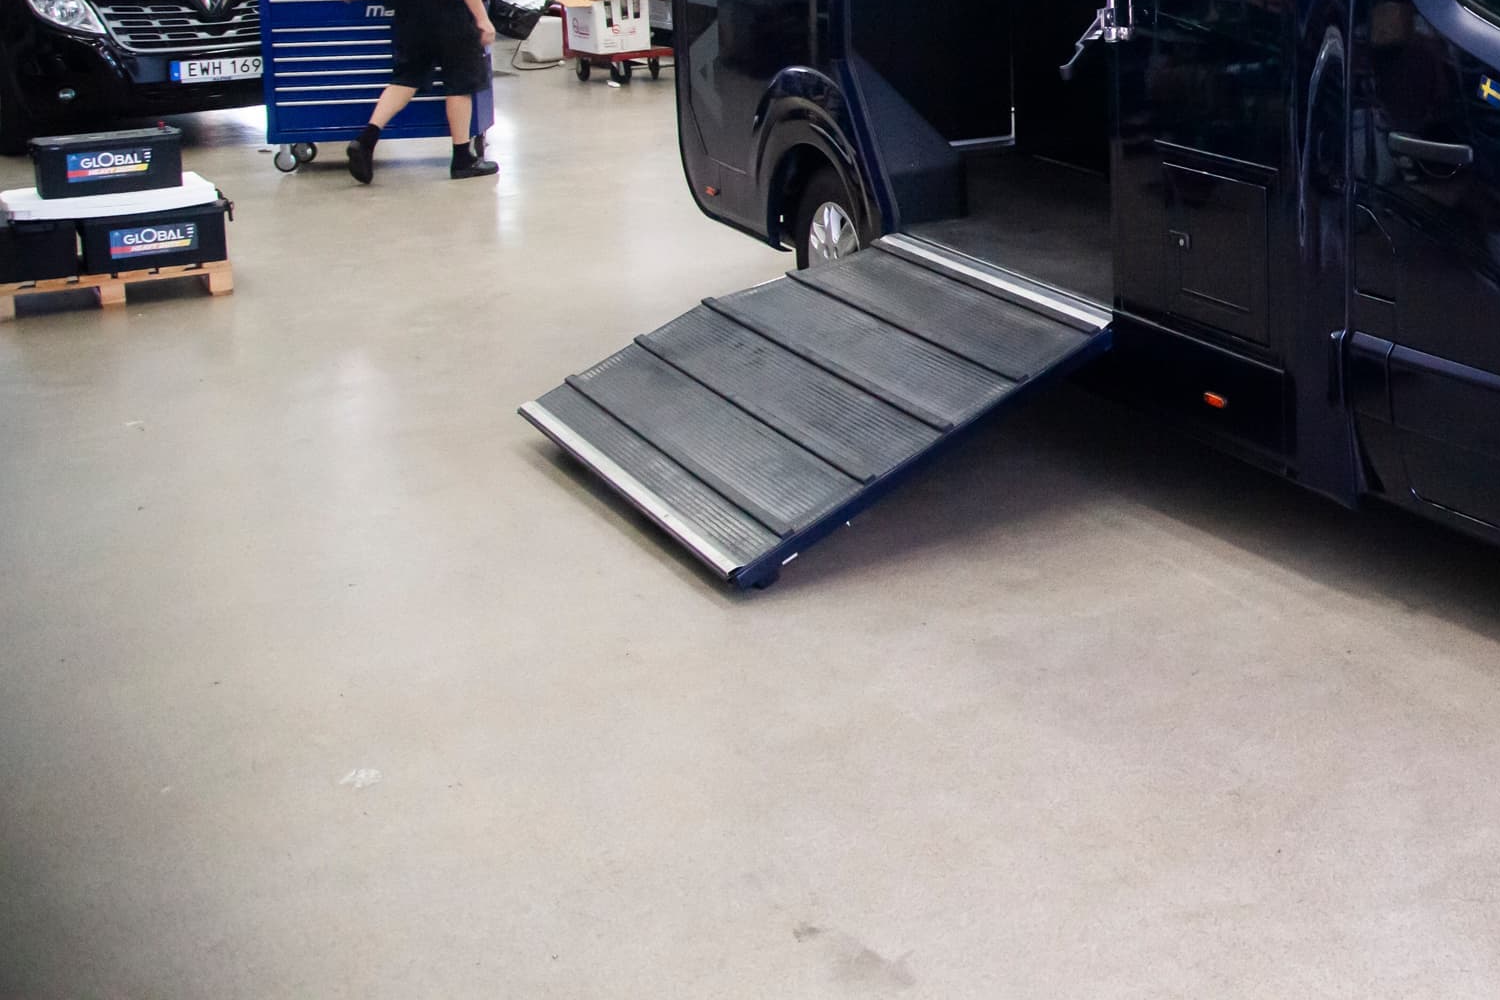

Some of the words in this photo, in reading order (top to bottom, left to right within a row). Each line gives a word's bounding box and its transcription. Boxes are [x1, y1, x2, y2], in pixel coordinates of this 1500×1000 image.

[188, 62, 222, 77] EWH
[231, 58, 262, 73] 169
[80, 152, 142, 169] GLOBAL
[123, 228, 185, 245] GLOBAL
